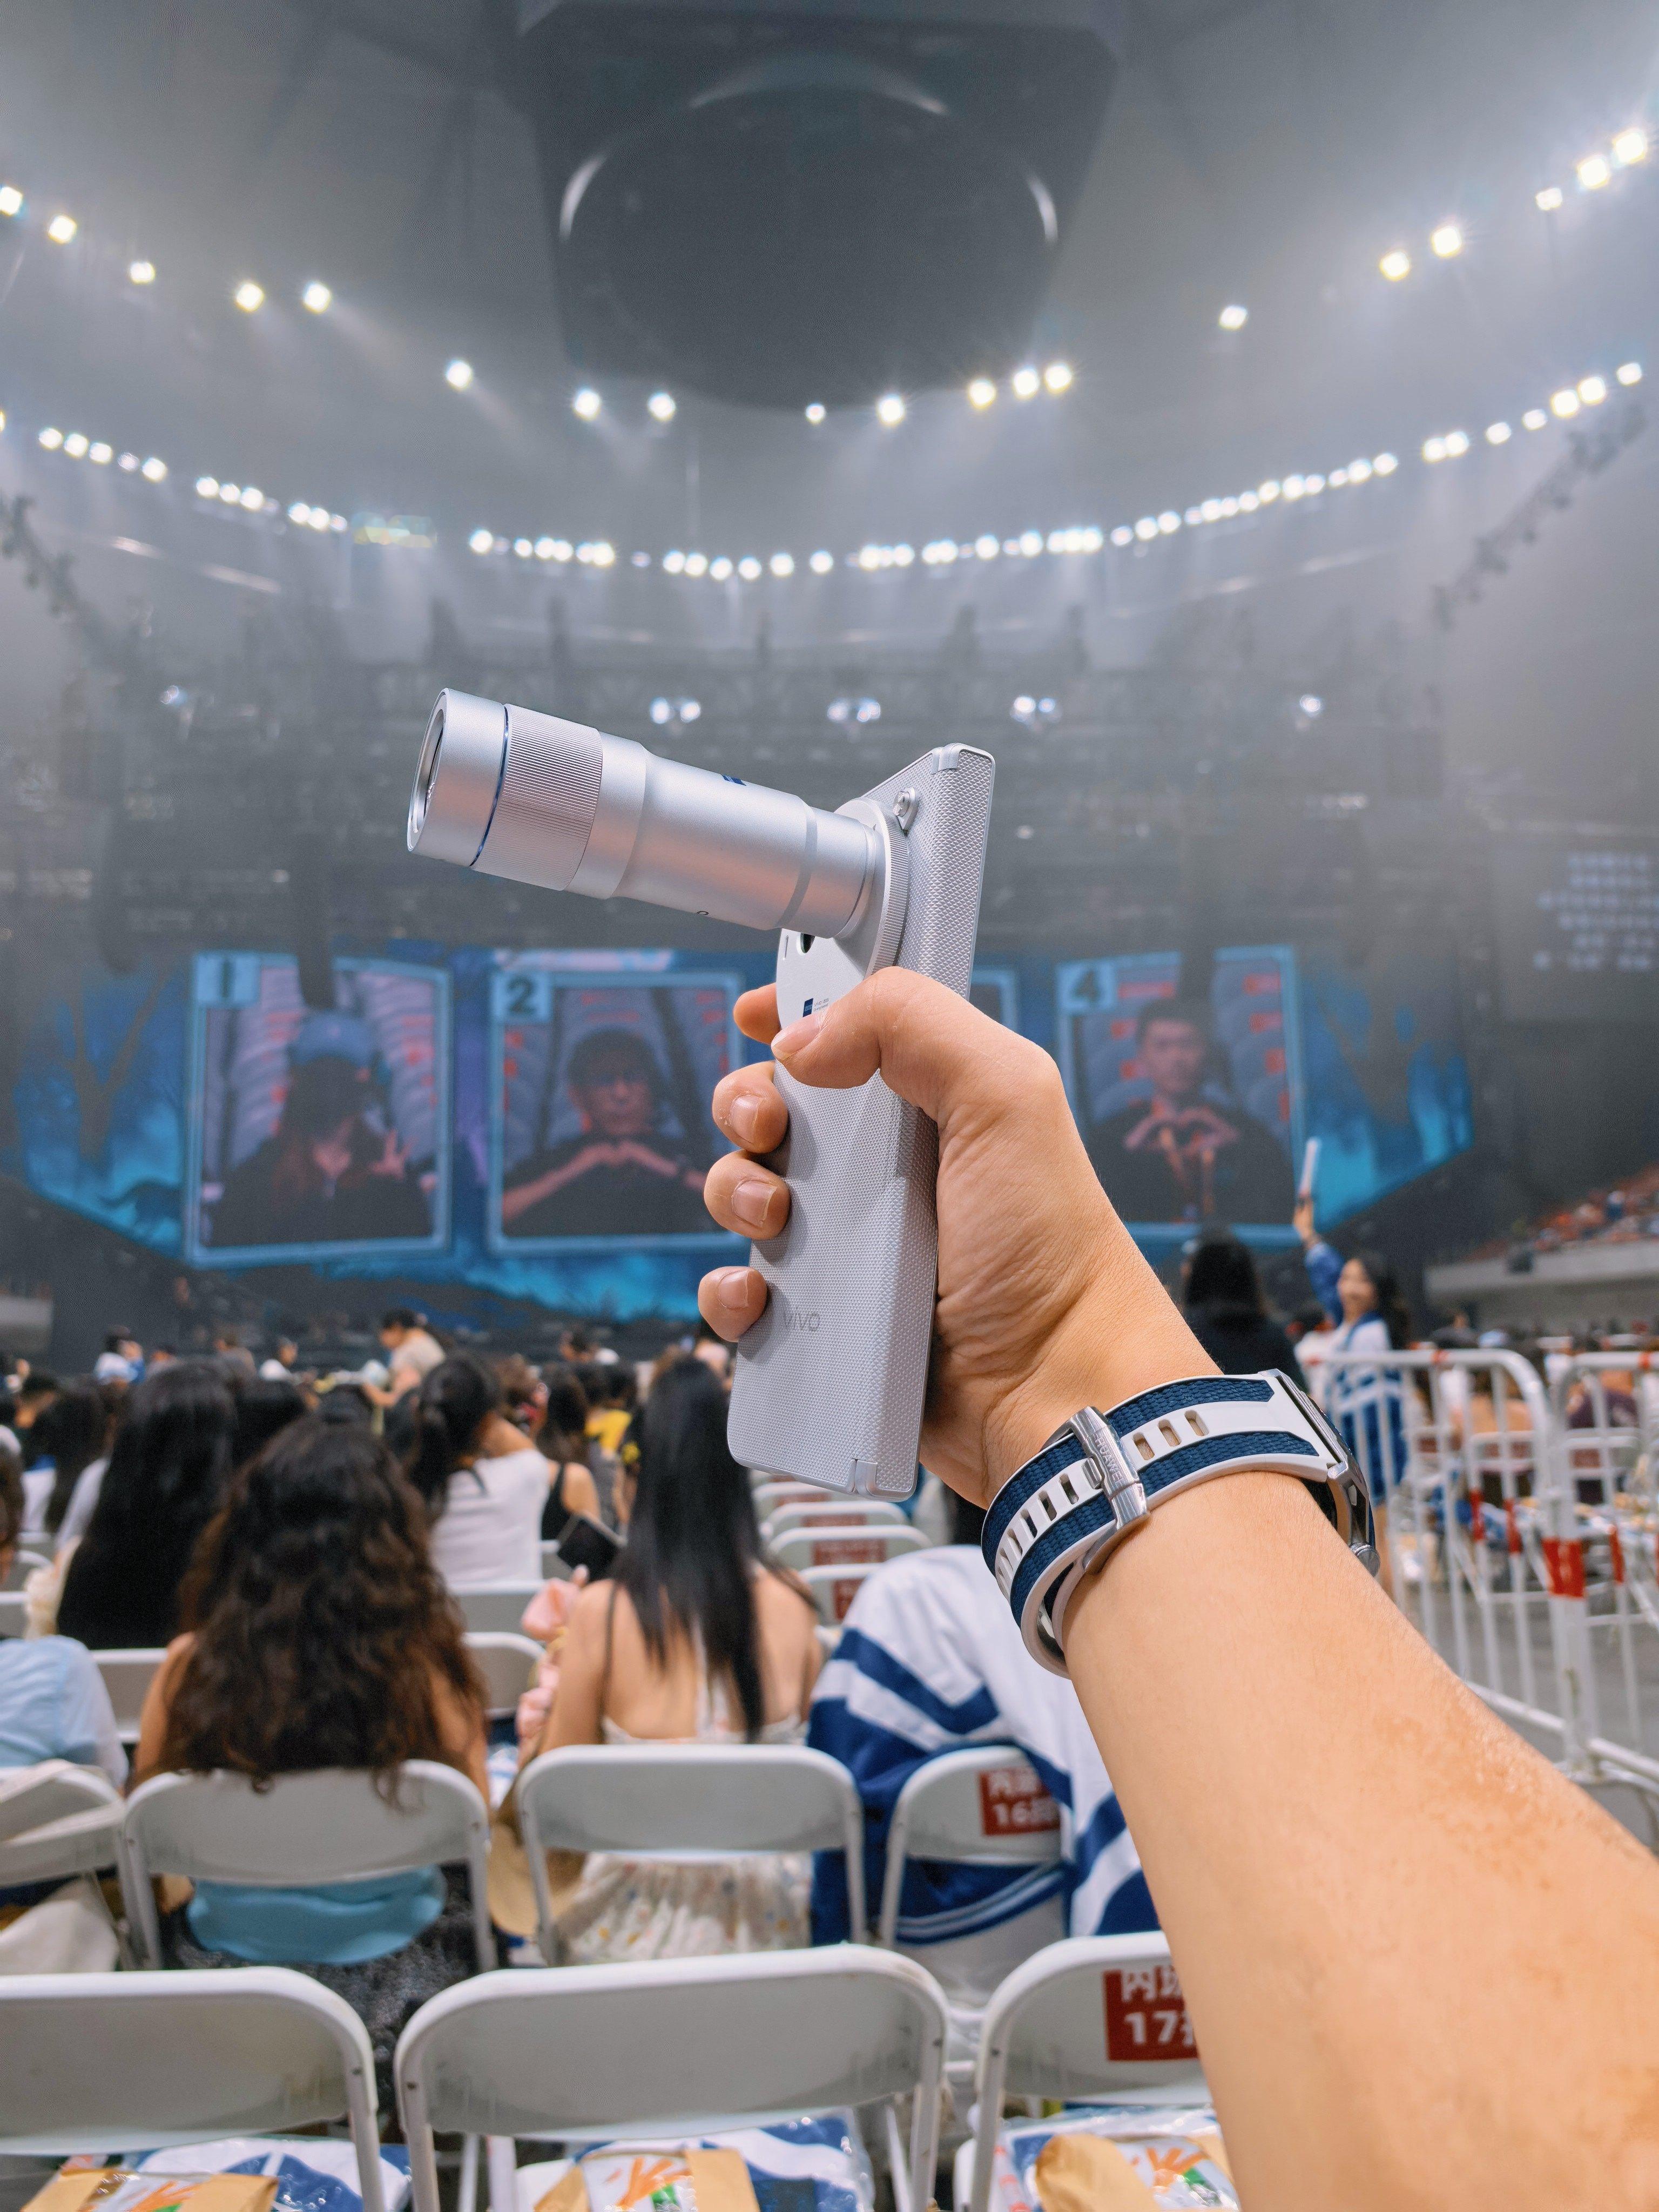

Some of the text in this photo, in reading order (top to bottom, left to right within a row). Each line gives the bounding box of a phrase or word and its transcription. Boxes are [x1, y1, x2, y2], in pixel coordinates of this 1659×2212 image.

[508, 975, 537, 1014] 2
[1072, 970, 1101, 1003] 4
[1093, 1434, 1125, 1484] HUAWEI
